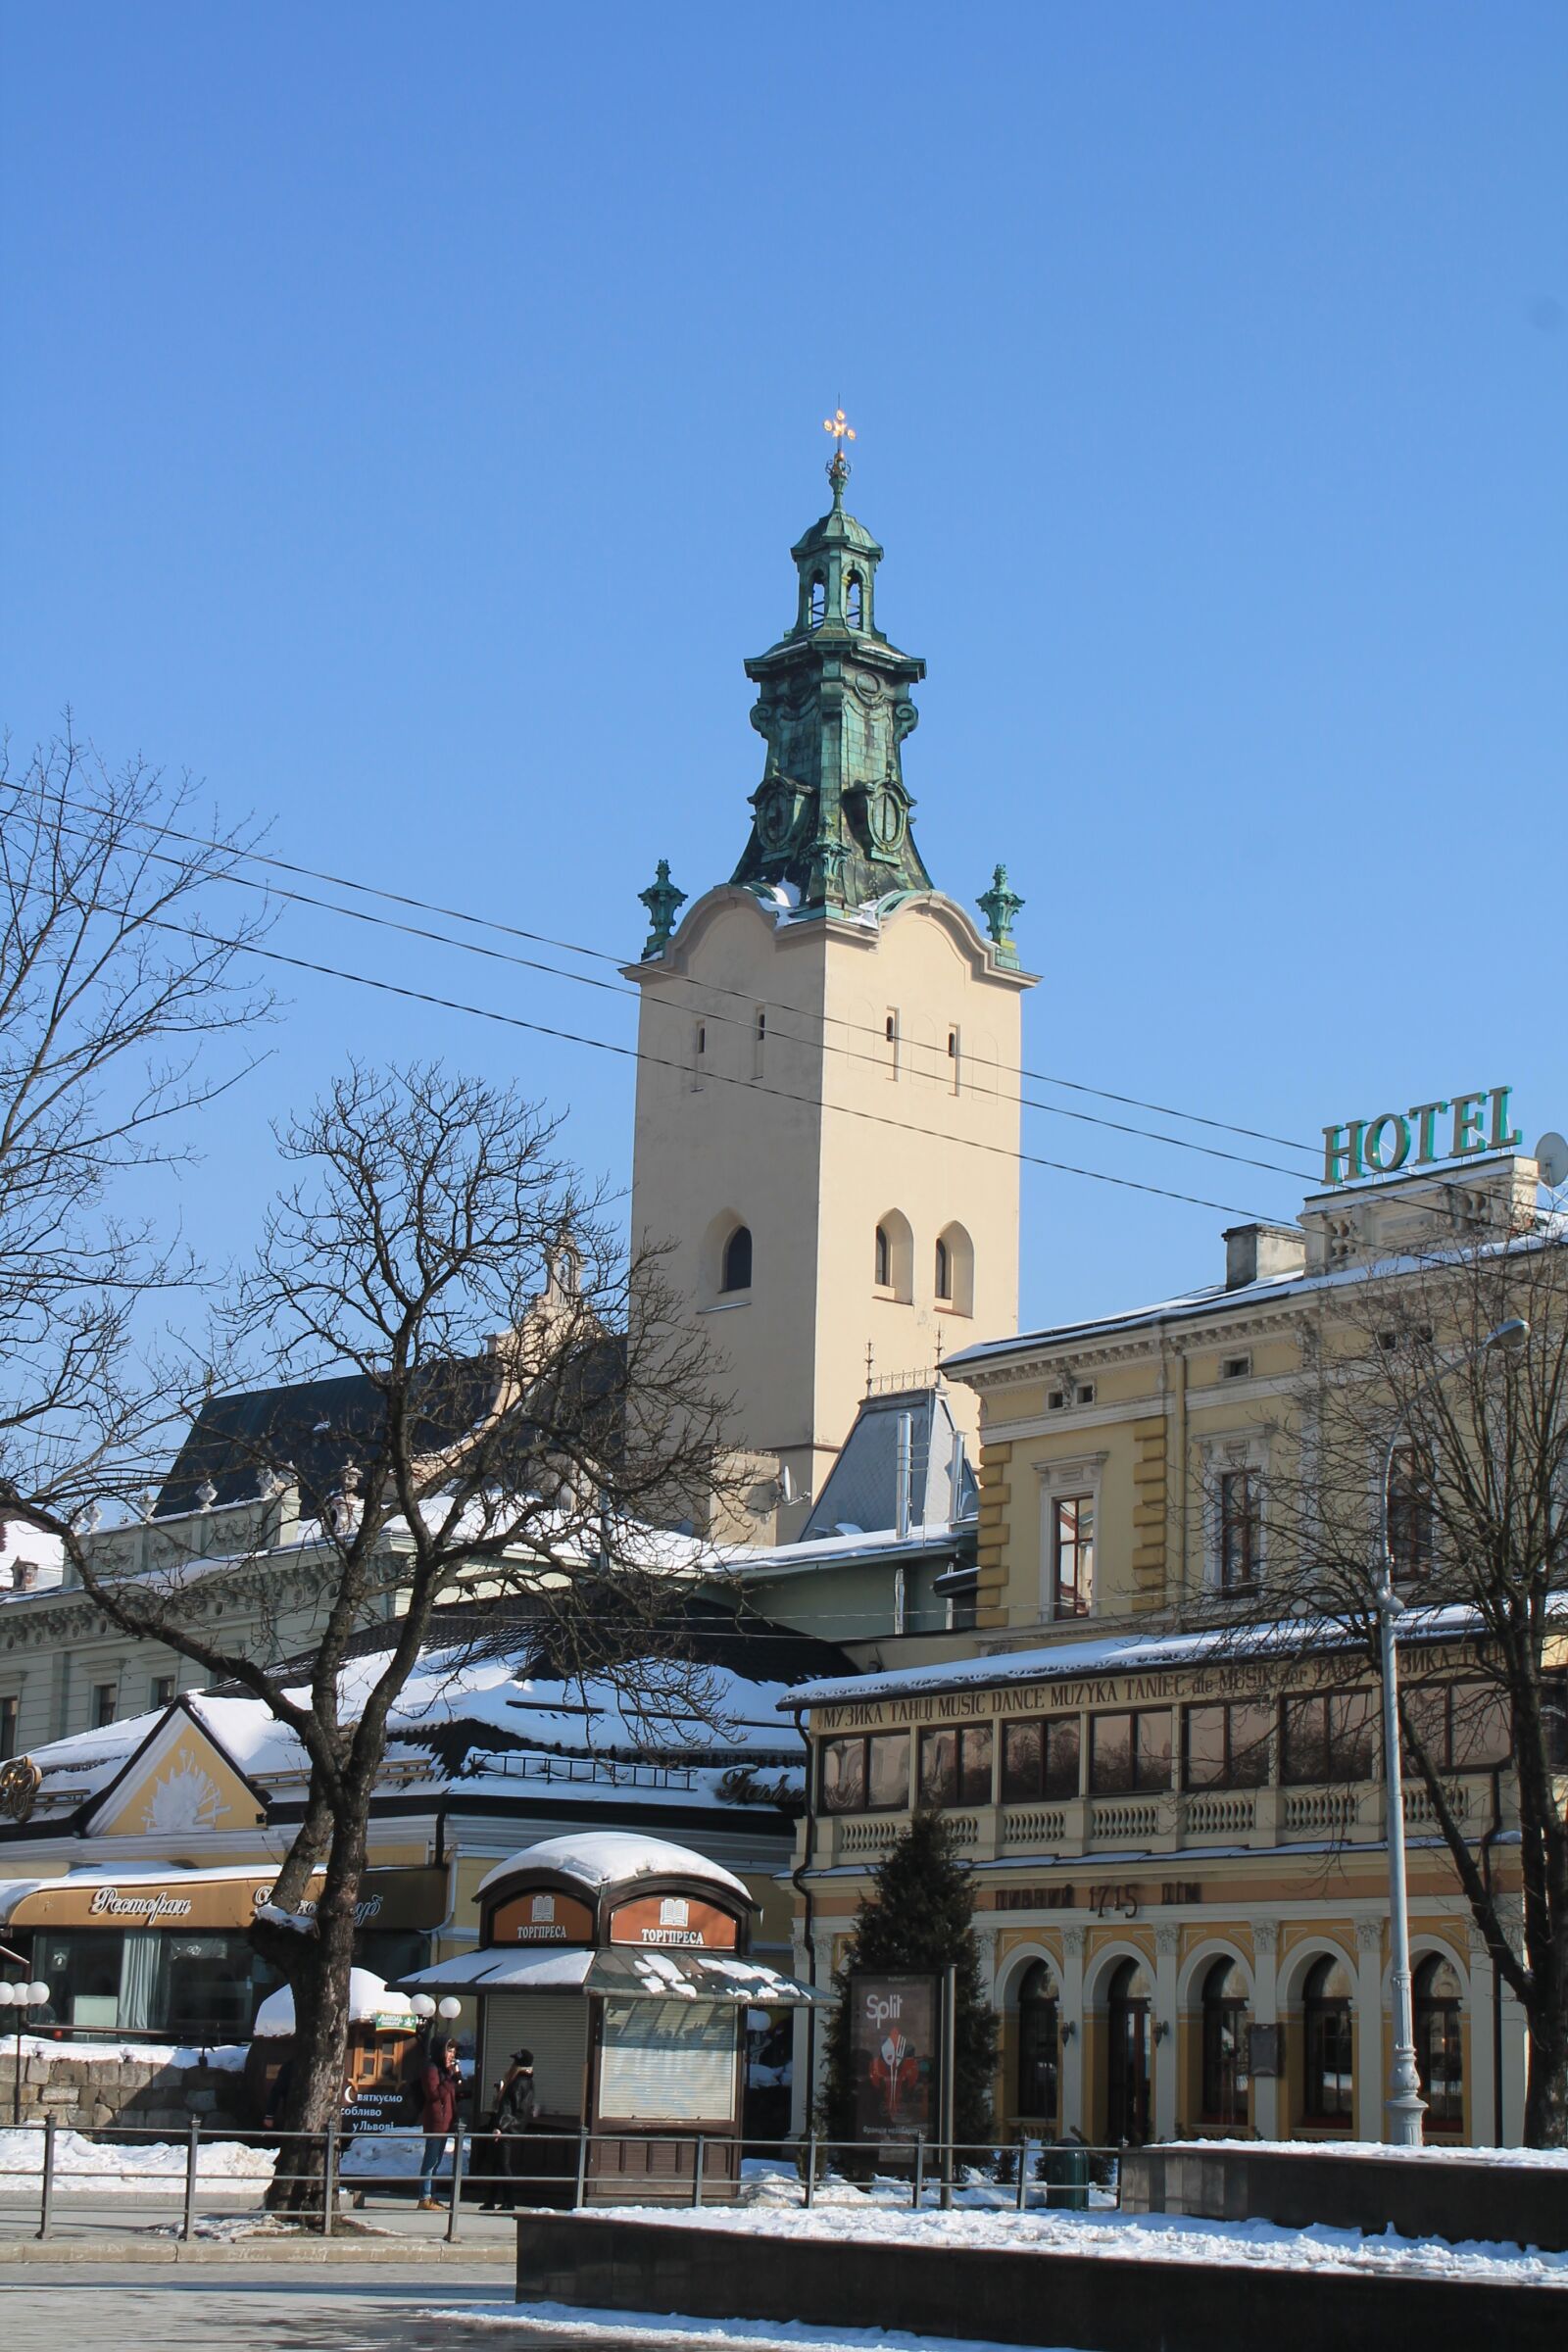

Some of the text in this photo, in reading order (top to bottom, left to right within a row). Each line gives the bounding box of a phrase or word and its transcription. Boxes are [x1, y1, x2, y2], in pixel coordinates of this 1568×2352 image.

[1321, 1085, 1523, 1185] HOTEL
[938, 1687, 1046, 1718] MUSIC DANCE
[1051, 1674, 1186, 1707] MUZYKA TANIEC
[823, 1697, 934, 1728] МУЗИКА ТАНЦІ
[90, 1886, 191, 1924] Ресторан
[1090, 1883, 1144, 1918] 1715
[517, 1925, 566, 1939] ТОРГПРЕСА
[641, 1928, 705, 1945] ТОРГПРЕСА
[865, 1993, 904, 2030] Split
[340, 2106, 382, 2117] собливо
[353, 2123, 359, 2132] у
